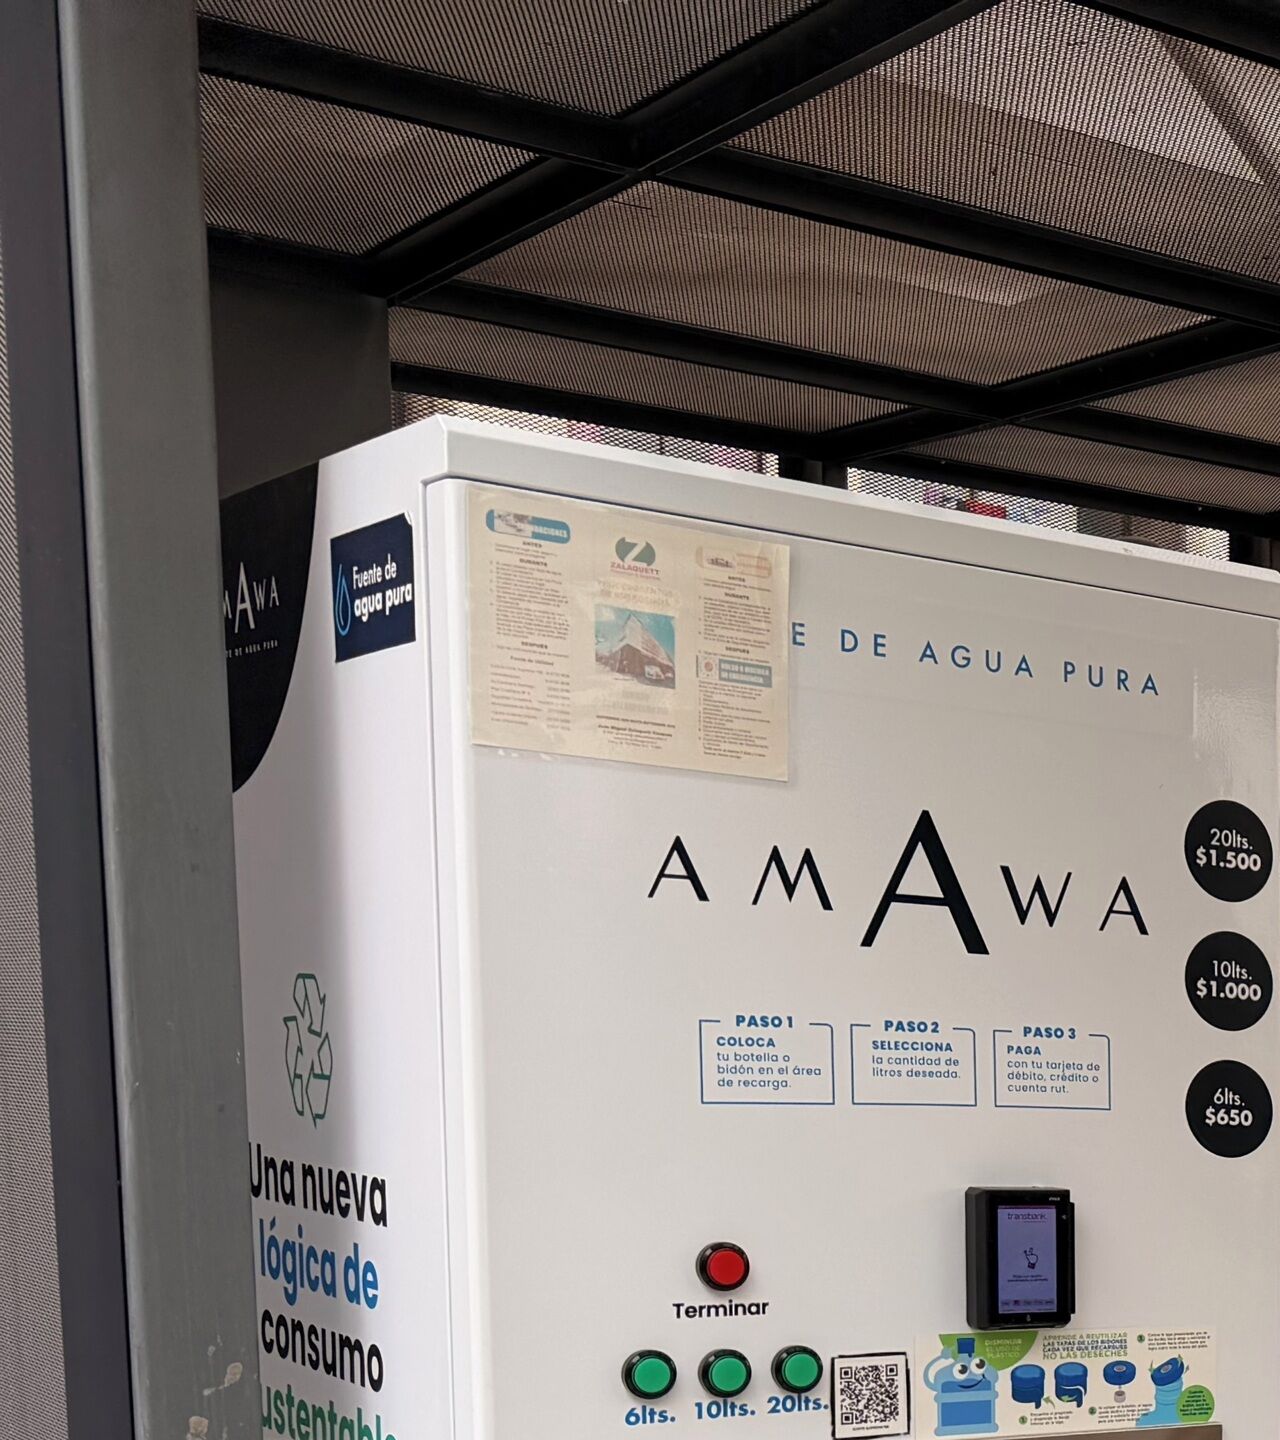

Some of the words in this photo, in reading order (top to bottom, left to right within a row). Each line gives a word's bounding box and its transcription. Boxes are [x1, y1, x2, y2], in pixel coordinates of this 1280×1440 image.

[352, 565, 382, 590] Fuente
[385, 553, 397, 581] de
[610, 561, 660, 575] ZALAQUETT
[354, 593, 382, 623] agua
[385, 582, 413, 616] pura
[840, 628, 887, 658] DE
[919, 640, 1033, 678] AGUA
[1063, 660, 1159, 696] PURA
[1210, 828, 1254, 850] 20lts.
[1196, 845, 1262, 872] $1.500
[648, 809, 1149, 956] AMAWA
[1212, 960, 1253, 980] 10lts.
[1196, 977, 1262, 1002] $1.000
[735, 1014, 783, 1029] PASO
[786, 1016, 794, 1029] 1
[884, 1020, 929, 1033] PASO
[930, 1021, 941, 1034] 2
[716, 1036, 776, 1048] COLOCA
[1023, 1026, 1064, 1039] PASO
[1067, 1028, 1077, 1040] 3
[872, 1040, 953, 1053] SELECCIONA
[1007, 1045, 1042, 1056] PAGA
[716, 1051, 730, 1062] tu
[733, 1051, 779, 1063] botella
[782, 1054, 791, 1063] o
[872, 1055, 884, 1066] la
[887, 1055, 941, 1067] cantidad
[944, 1057, 960, 1067] de
[1007, 1060, 1028, 1069] con
[1031, 1060, 1043, 1069] tu
[1046, 1060, 1083, 1073] tarjeta
[1086, 1061, 1100, 1071] de
[717, 1064, 754, 1076] bidón
[758, 1066, 774, 1076] en
[777, 1065, 789, 1076] el
[792, 1065, 822, 1076] área
[872, 1067, 903, 1077] litros
[906, 1067, 961, 1079] deseada.
[1007, 1070, 1047, 1083] débito,
[1049, 1071, 1089, 1083] crédito
[1091, 1074, 1099, 1083] o
[717, 1077, 734, 1088] de
[737, 1079, 792, 1090] recarga.
[1007, 1083, 1047, 1093] cuenta
[1050, 1084, 1069, 1094] rut.
[1213, 1087, 1246, 1106] 6lts.
[1205, 1105, 1254, 1127] $650
[249, 1142, 296, 1207] Una
[302, 1163, 388, 1228] nueva
[259, 1216, 337, 1306] lógica
[343, 1242, 379, 1310] de
[672, 1299, 770, 1319] Terminar
[261, 1309, 384, 1393] consumo
[1042, 1352, 1058, 1360] NO
[1060, 1351, 1078, 1359] LAS
[1080, 1350, 1128, 1359] DESECHES
[694, 1399, 756, 1420] 10lts.
[766, 1393, 830, 1414] 20lts.
[624, 1405, 676, 1426] 6lts.
